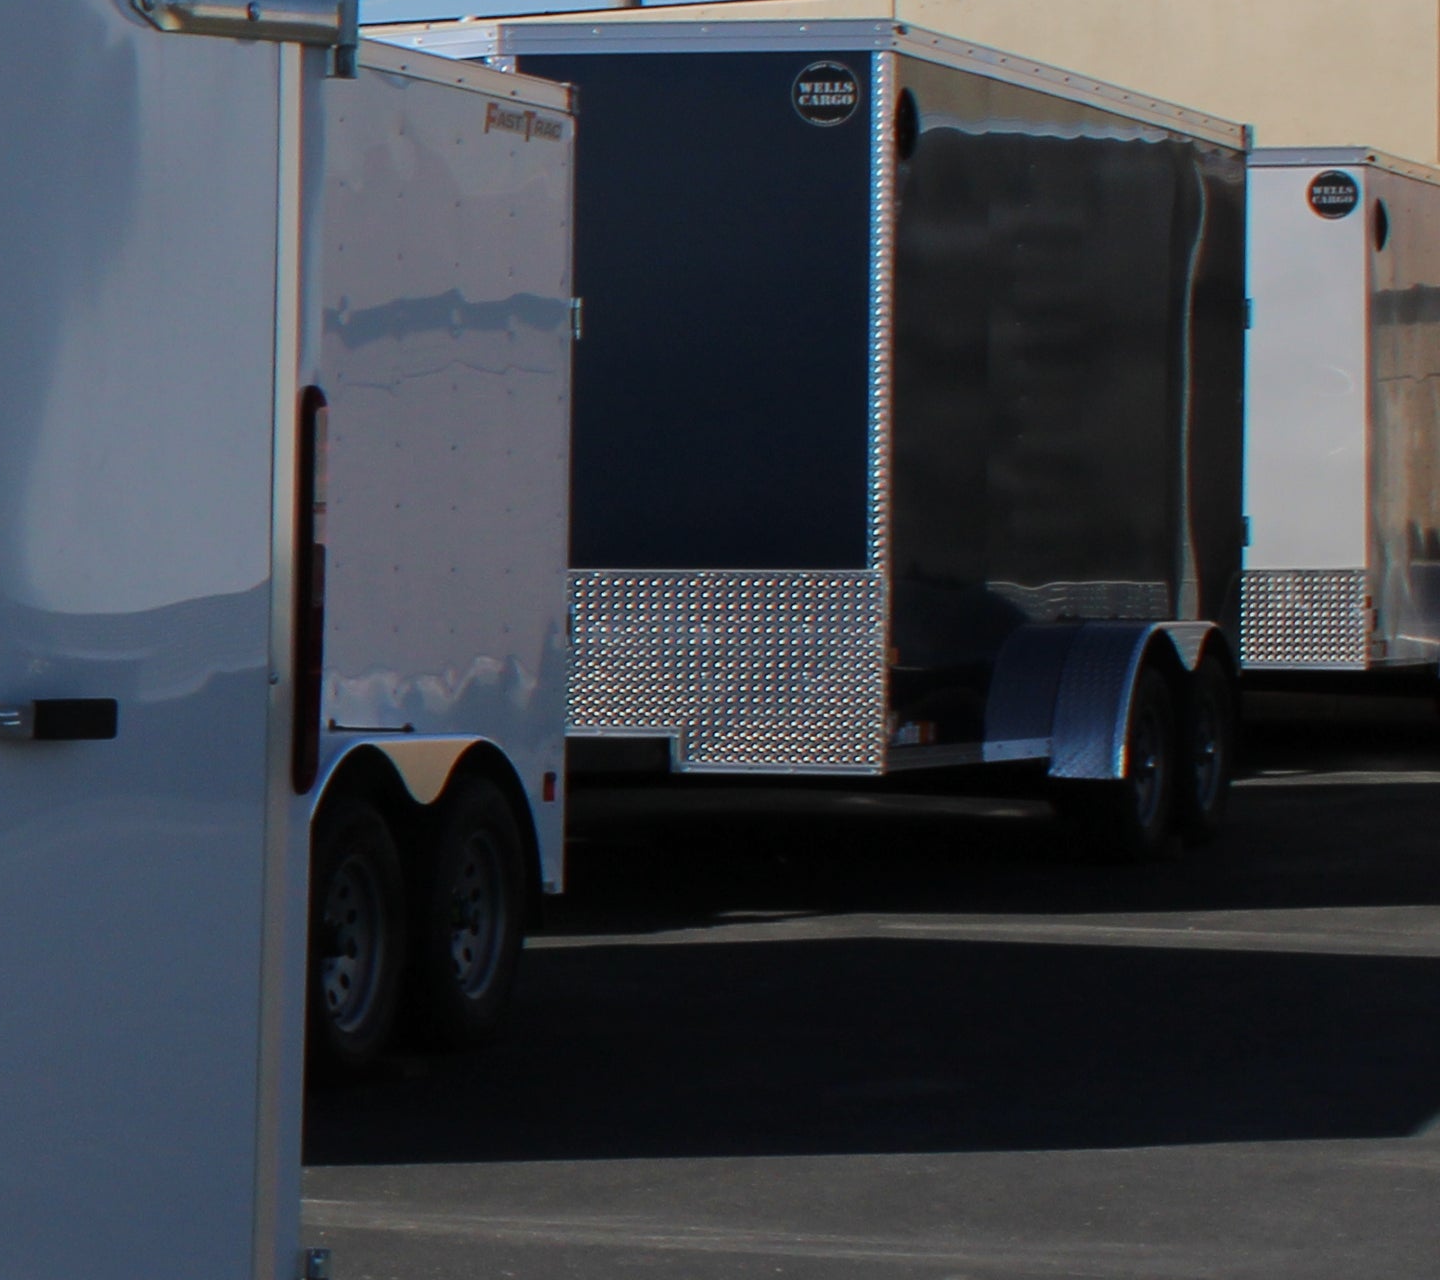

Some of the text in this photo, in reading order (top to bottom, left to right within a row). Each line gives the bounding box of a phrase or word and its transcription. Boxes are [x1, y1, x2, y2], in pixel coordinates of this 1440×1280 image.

[798, 81, 855, 93] WELLS
[797, 93, 855, 106] CARGO
[1312, 185, 1354, 195] WELLS
